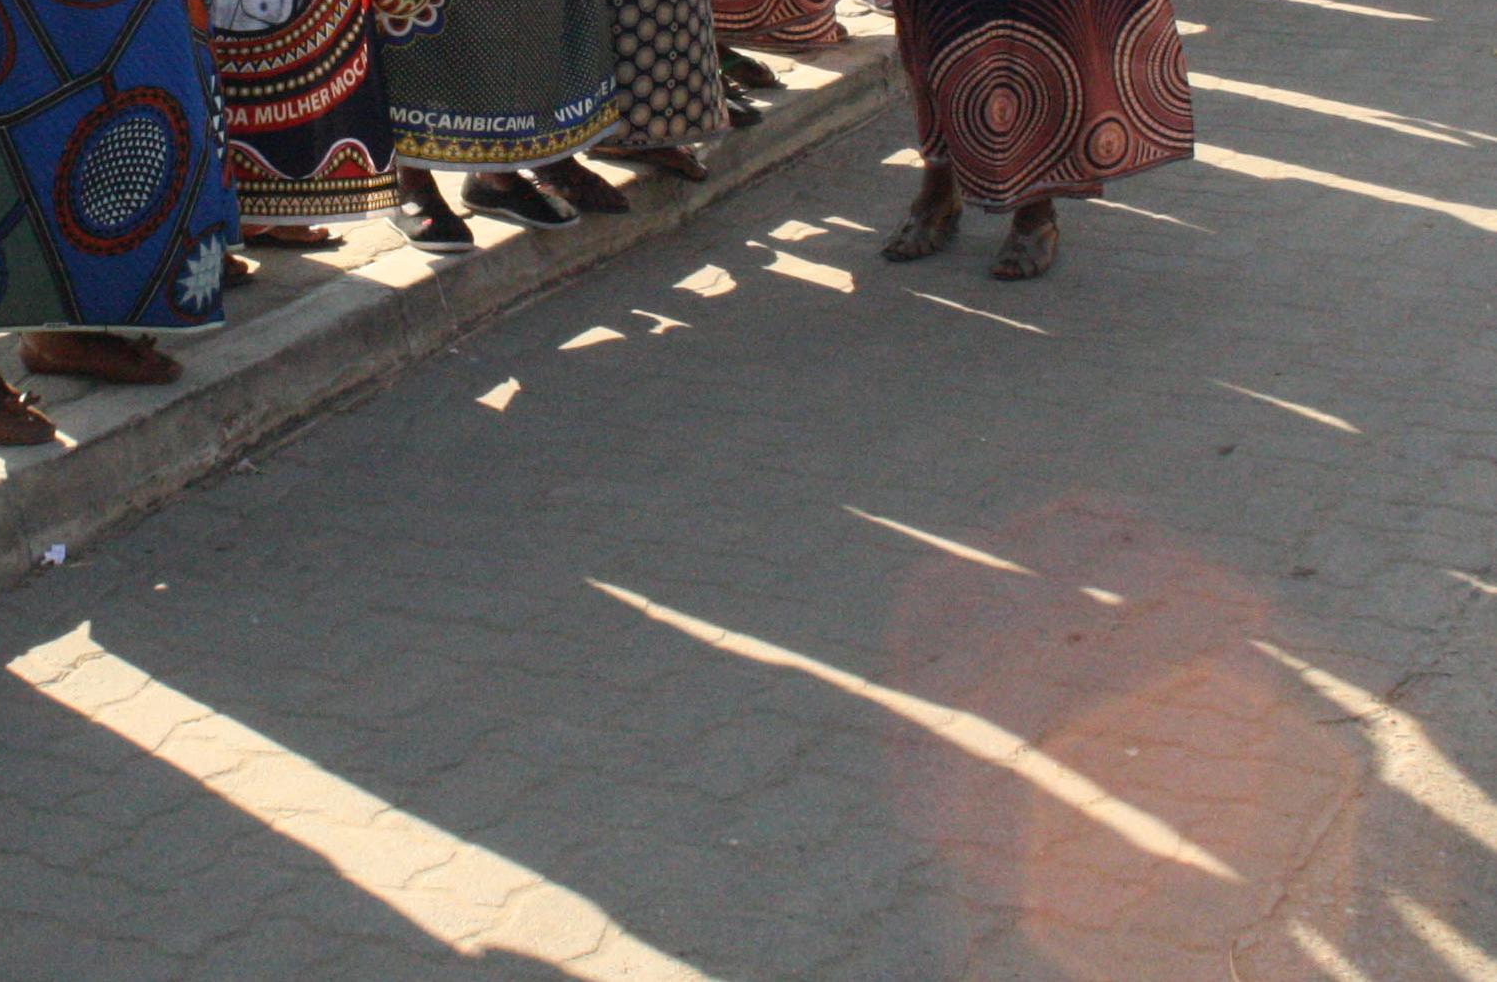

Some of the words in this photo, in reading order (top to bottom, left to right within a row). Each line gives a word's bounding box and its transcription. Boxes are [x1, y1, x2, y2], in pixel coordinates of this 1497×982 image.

[254, 87, 331, 124] MULHER
[554, 98, 593, 123] VIVA
[389, 106, 536, 134] MOÇAMBICANA
